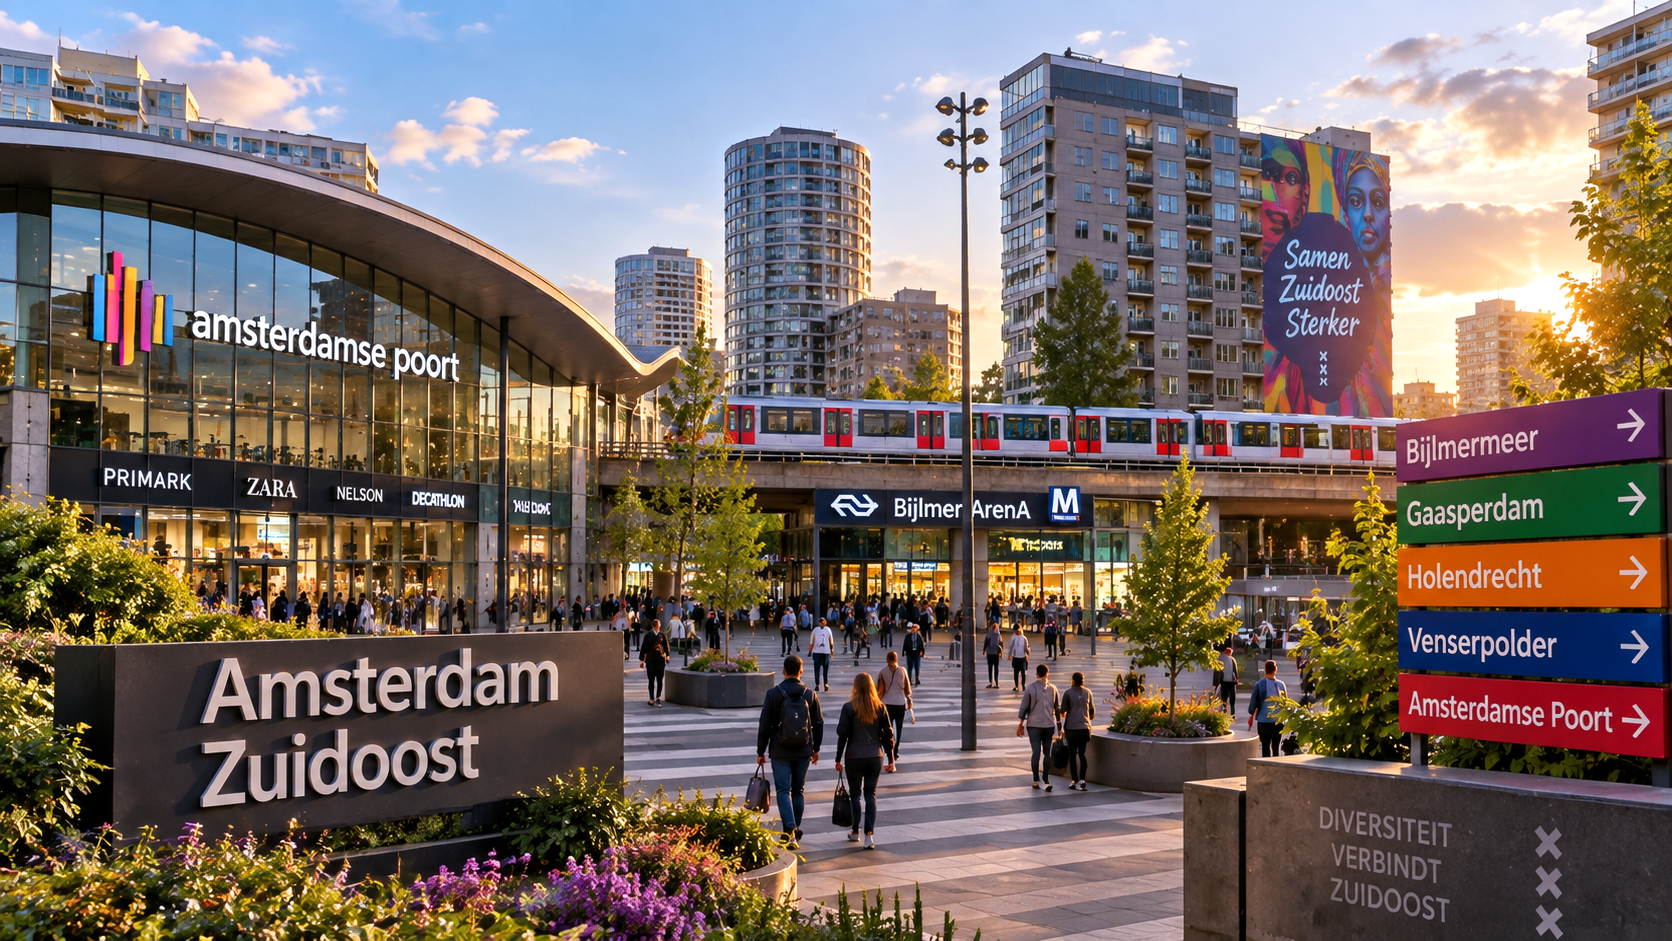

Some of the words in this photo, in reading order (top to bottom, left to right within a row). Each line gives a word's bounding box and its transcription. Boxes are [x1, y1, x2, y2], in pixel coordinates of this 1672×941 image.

[1284, 239, 1352, 270] Samen
[1279, 274, 1364, 304] Zuidoost
[1285, 307, 1361, 338] Sterker
[192, 310, 387, 368] amsterdamse
[394, 347, 460, 382] poort
[1406, 427, 1539, 469] Bijlmermeer
[104, 467, 192, 491] PRIMARK
[246, 477, 298, 499] ZARA
[336, 486, 383, 503] NELSON
[411, 491, 465, 509] DECATHLON
[894, 497, 963, 523] Bijlmer
[972, 499, 1031, 519] ArenA
[1052, 488, 1079, 514] M
[1406, 492, 1544, 531] Gaasperdam
[1407, 559, 1543, 590] Holendrecht
[1407, 626, 1558, 663] Venserpolder
[200, 648, 559, 724] Amsterdam
[1408, 690, 1545, 727] Amsterdamse
[1551, 701, 1614, 733] Poort
[201, 725, 480, 808] Zuidoost
[1319, 806, 1453, 848] DIVERSITEIT
[1331, 843, 1442, 885] VERBINDT
[1330, 877, 1450, 923] ZUIDOOST
